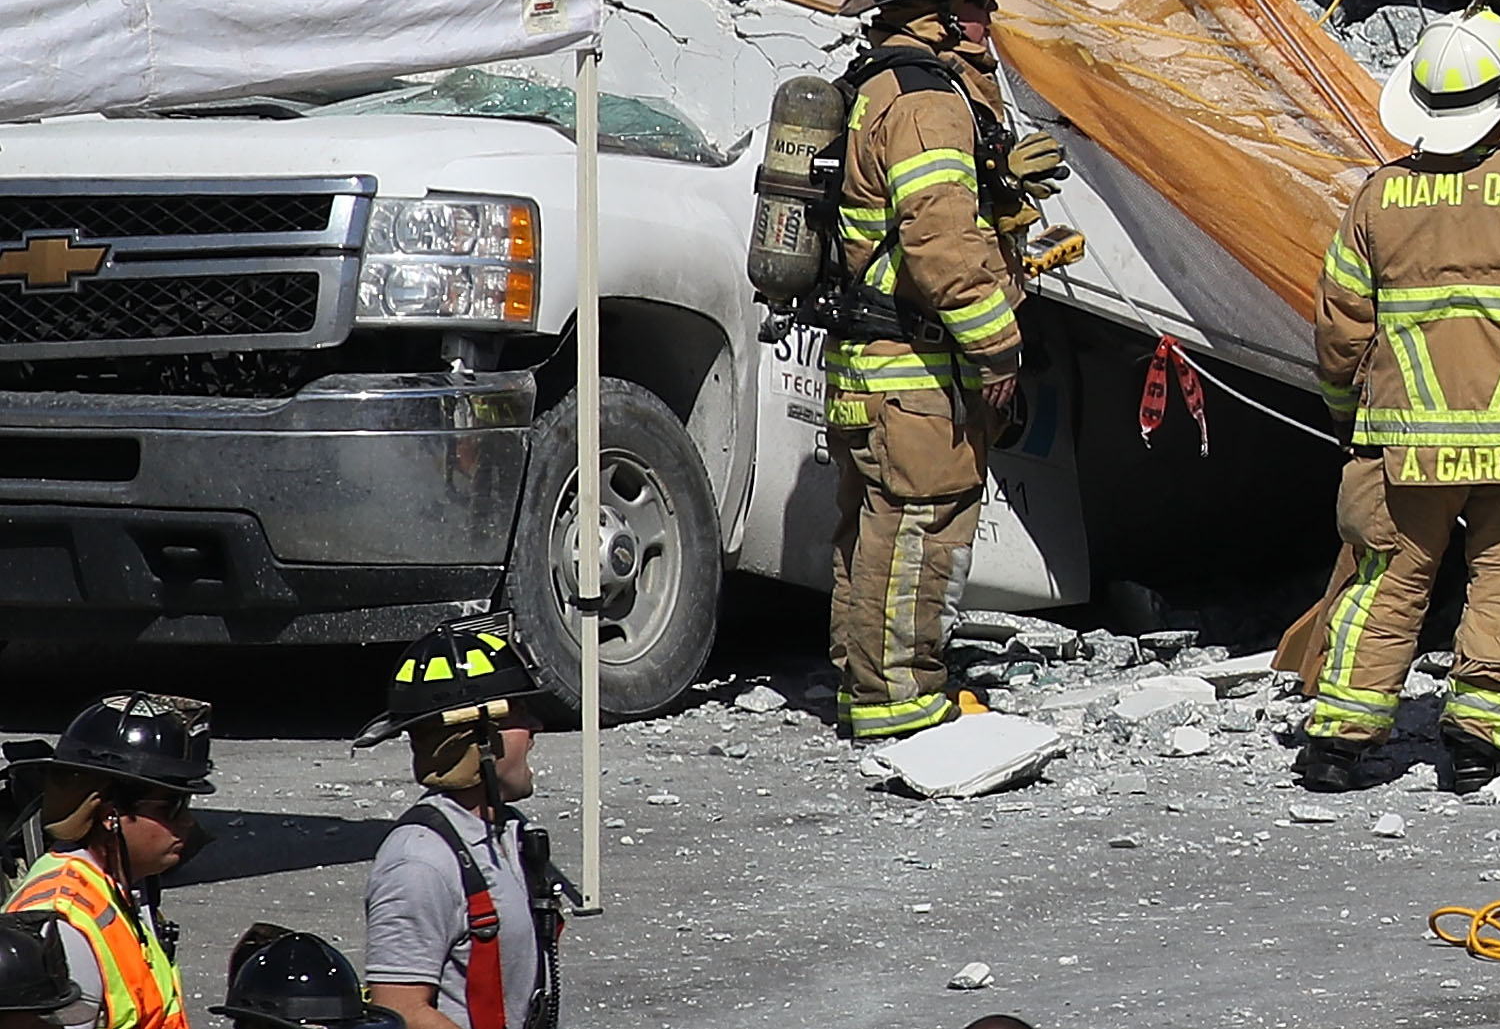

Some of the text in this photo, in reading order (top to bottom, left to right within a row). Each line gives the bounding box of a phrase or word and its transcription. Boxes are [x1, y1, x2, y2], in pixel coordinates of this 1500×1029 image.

[773, 140, 817, 158] MDFR
[783, 205, 802, 252] SCOTT
[1400, 446, 1427, 482] A.
